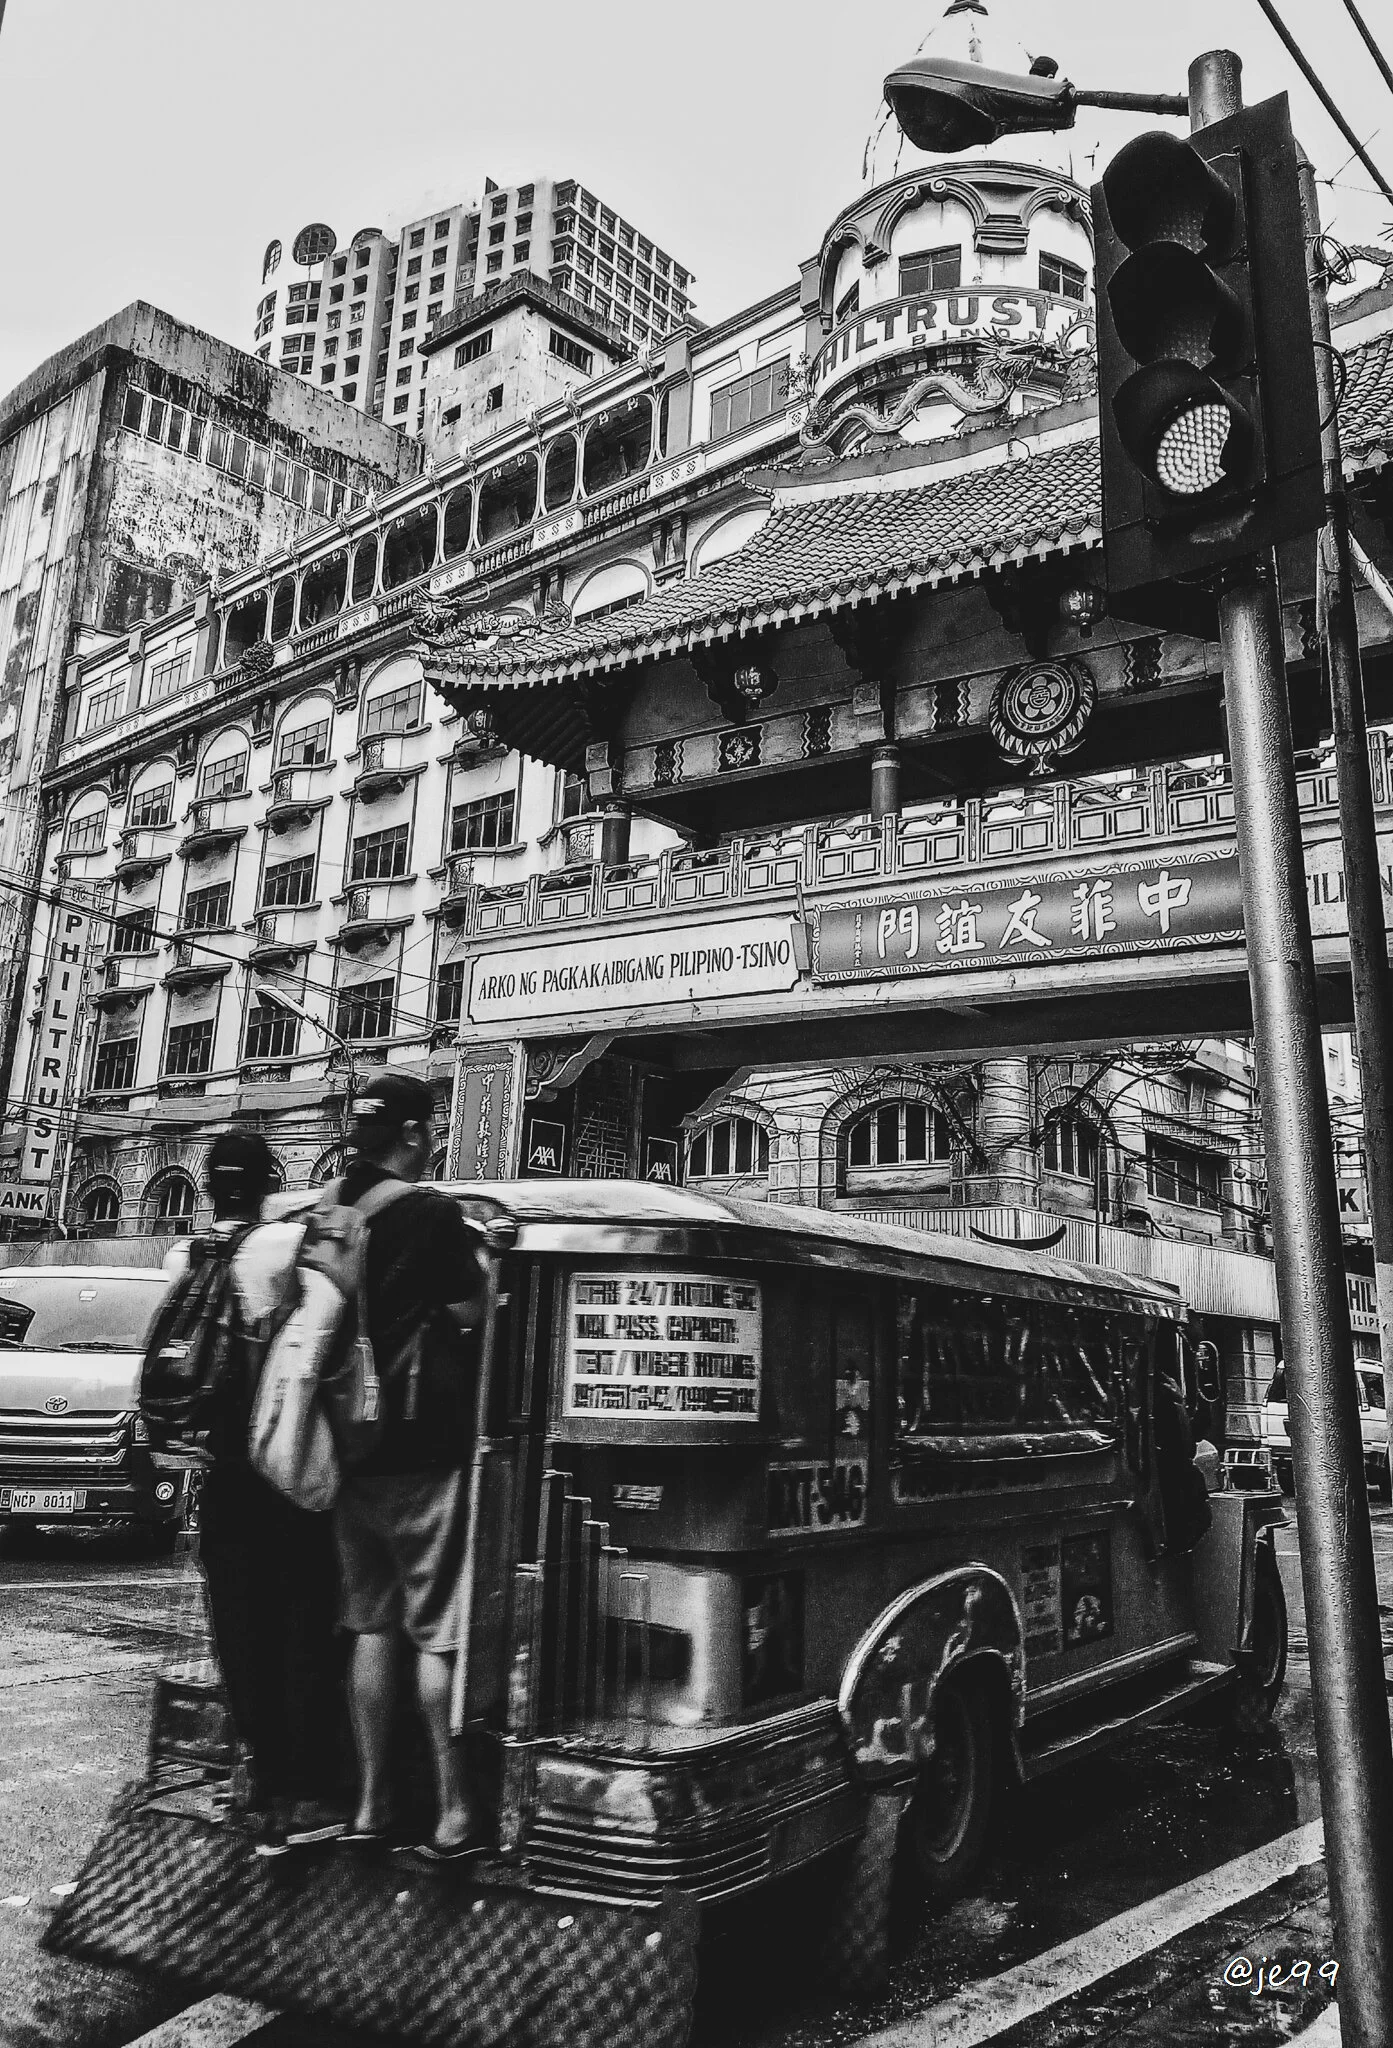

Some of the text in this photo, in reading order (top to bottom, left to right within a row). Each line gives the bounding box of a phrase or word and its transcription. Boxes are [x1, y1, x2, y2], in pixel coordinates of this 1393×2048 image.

[812, 297, 1054, 389] PHILTRUST
[876, 869, 1192, 959] 中菲友誼門
[478, 973, 516, 1000] ARKO
[519, 974, 537, 996] NG
[542, 953, 664, 993] PAGKAKAIBIGANG
[31, 914, 83, 1170] PHILTRUST
[529, 1145, 556, 1167] AXA
[647, 1161, 672, 1181] AXA
[13, 1494, 73, 1509] NCP 8011
